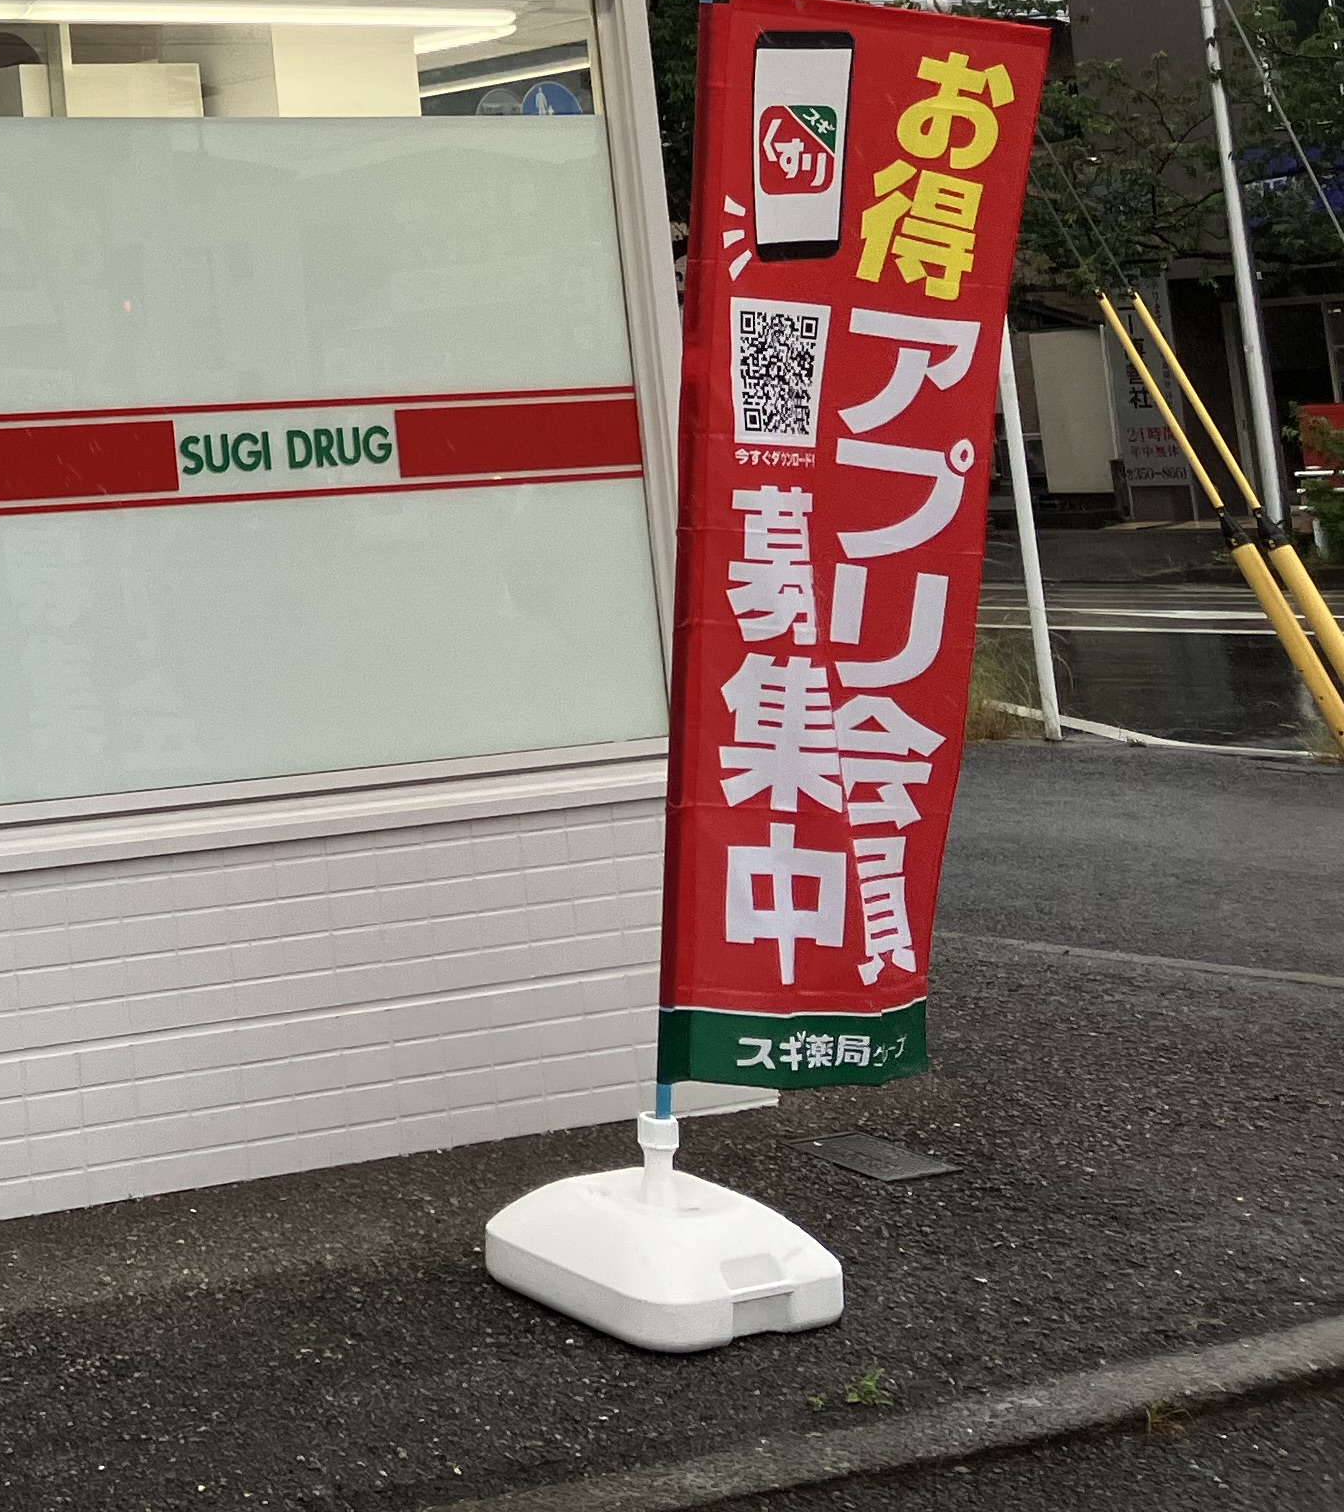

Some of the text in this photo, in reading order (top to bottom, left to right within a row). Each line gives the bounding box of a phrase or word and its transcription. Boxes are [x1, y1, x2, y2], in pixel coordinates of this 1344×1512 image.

[802, 108, 836, 134] スギ
[762, 118, 827, 187] くすり
[180, 425, 392, 475] SUGI DRUG
[718, 485, 847, 986] 募集中
